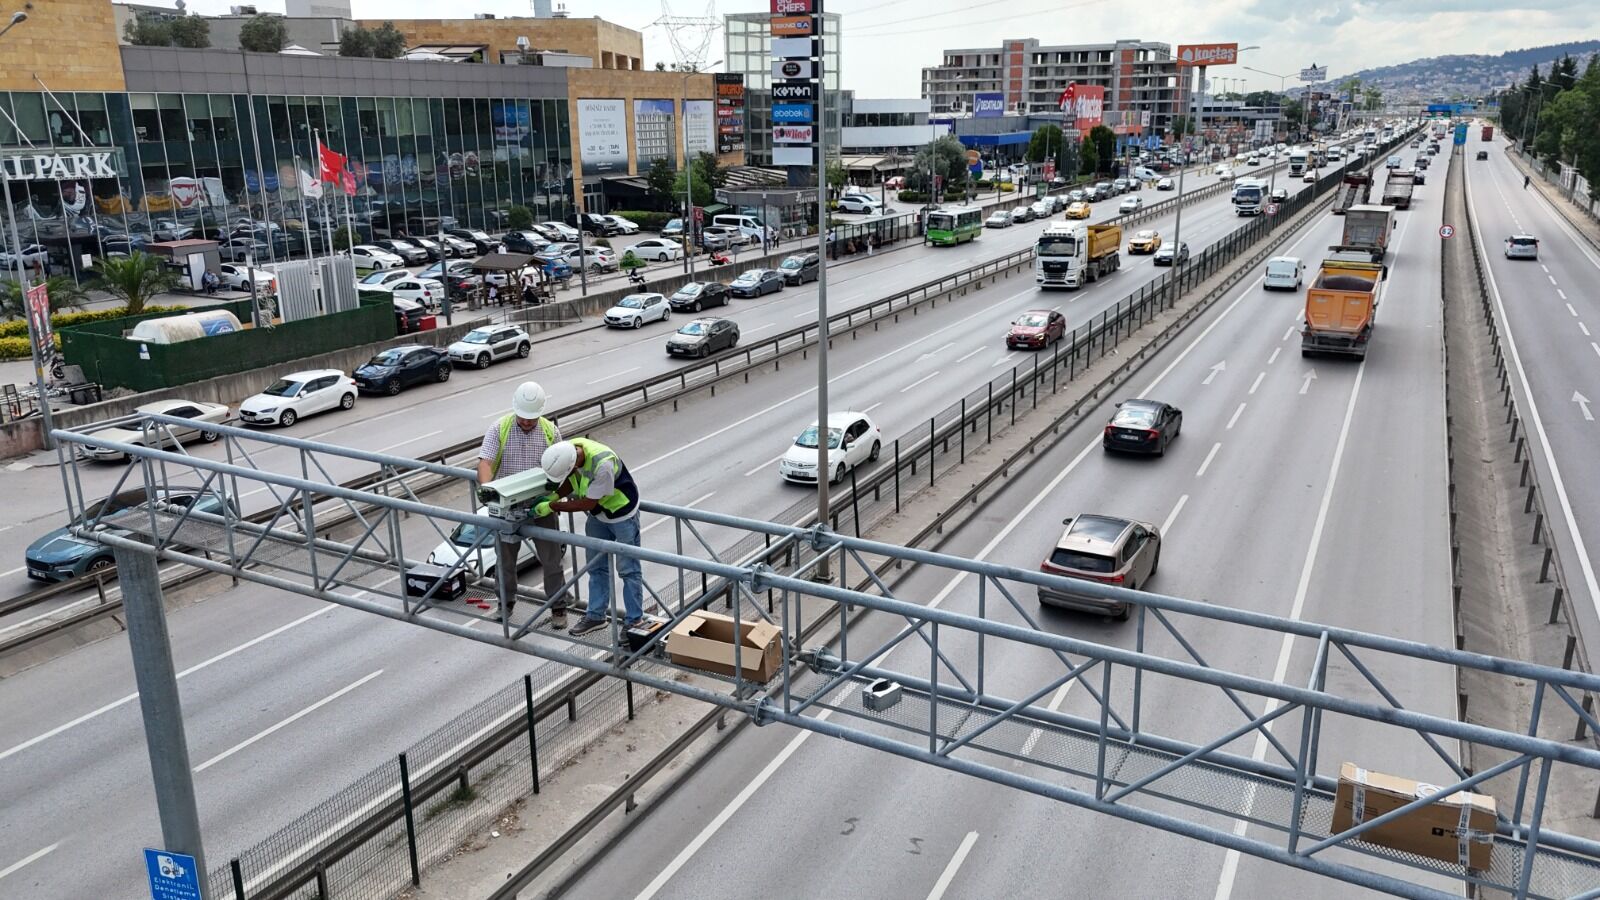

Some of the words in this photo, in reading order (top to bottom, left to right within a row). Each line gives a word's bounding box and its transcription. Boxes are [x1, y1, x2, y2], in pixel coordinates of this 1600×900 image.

[777, 2, 805, 12] CHEFS
[1195, 46, 1234, 62] koçtaş
[773, 86, 810, 97] KOTON
[980, 99, 1003, 111] DECATHLON
[774, 109, 803, 117] ebebek
